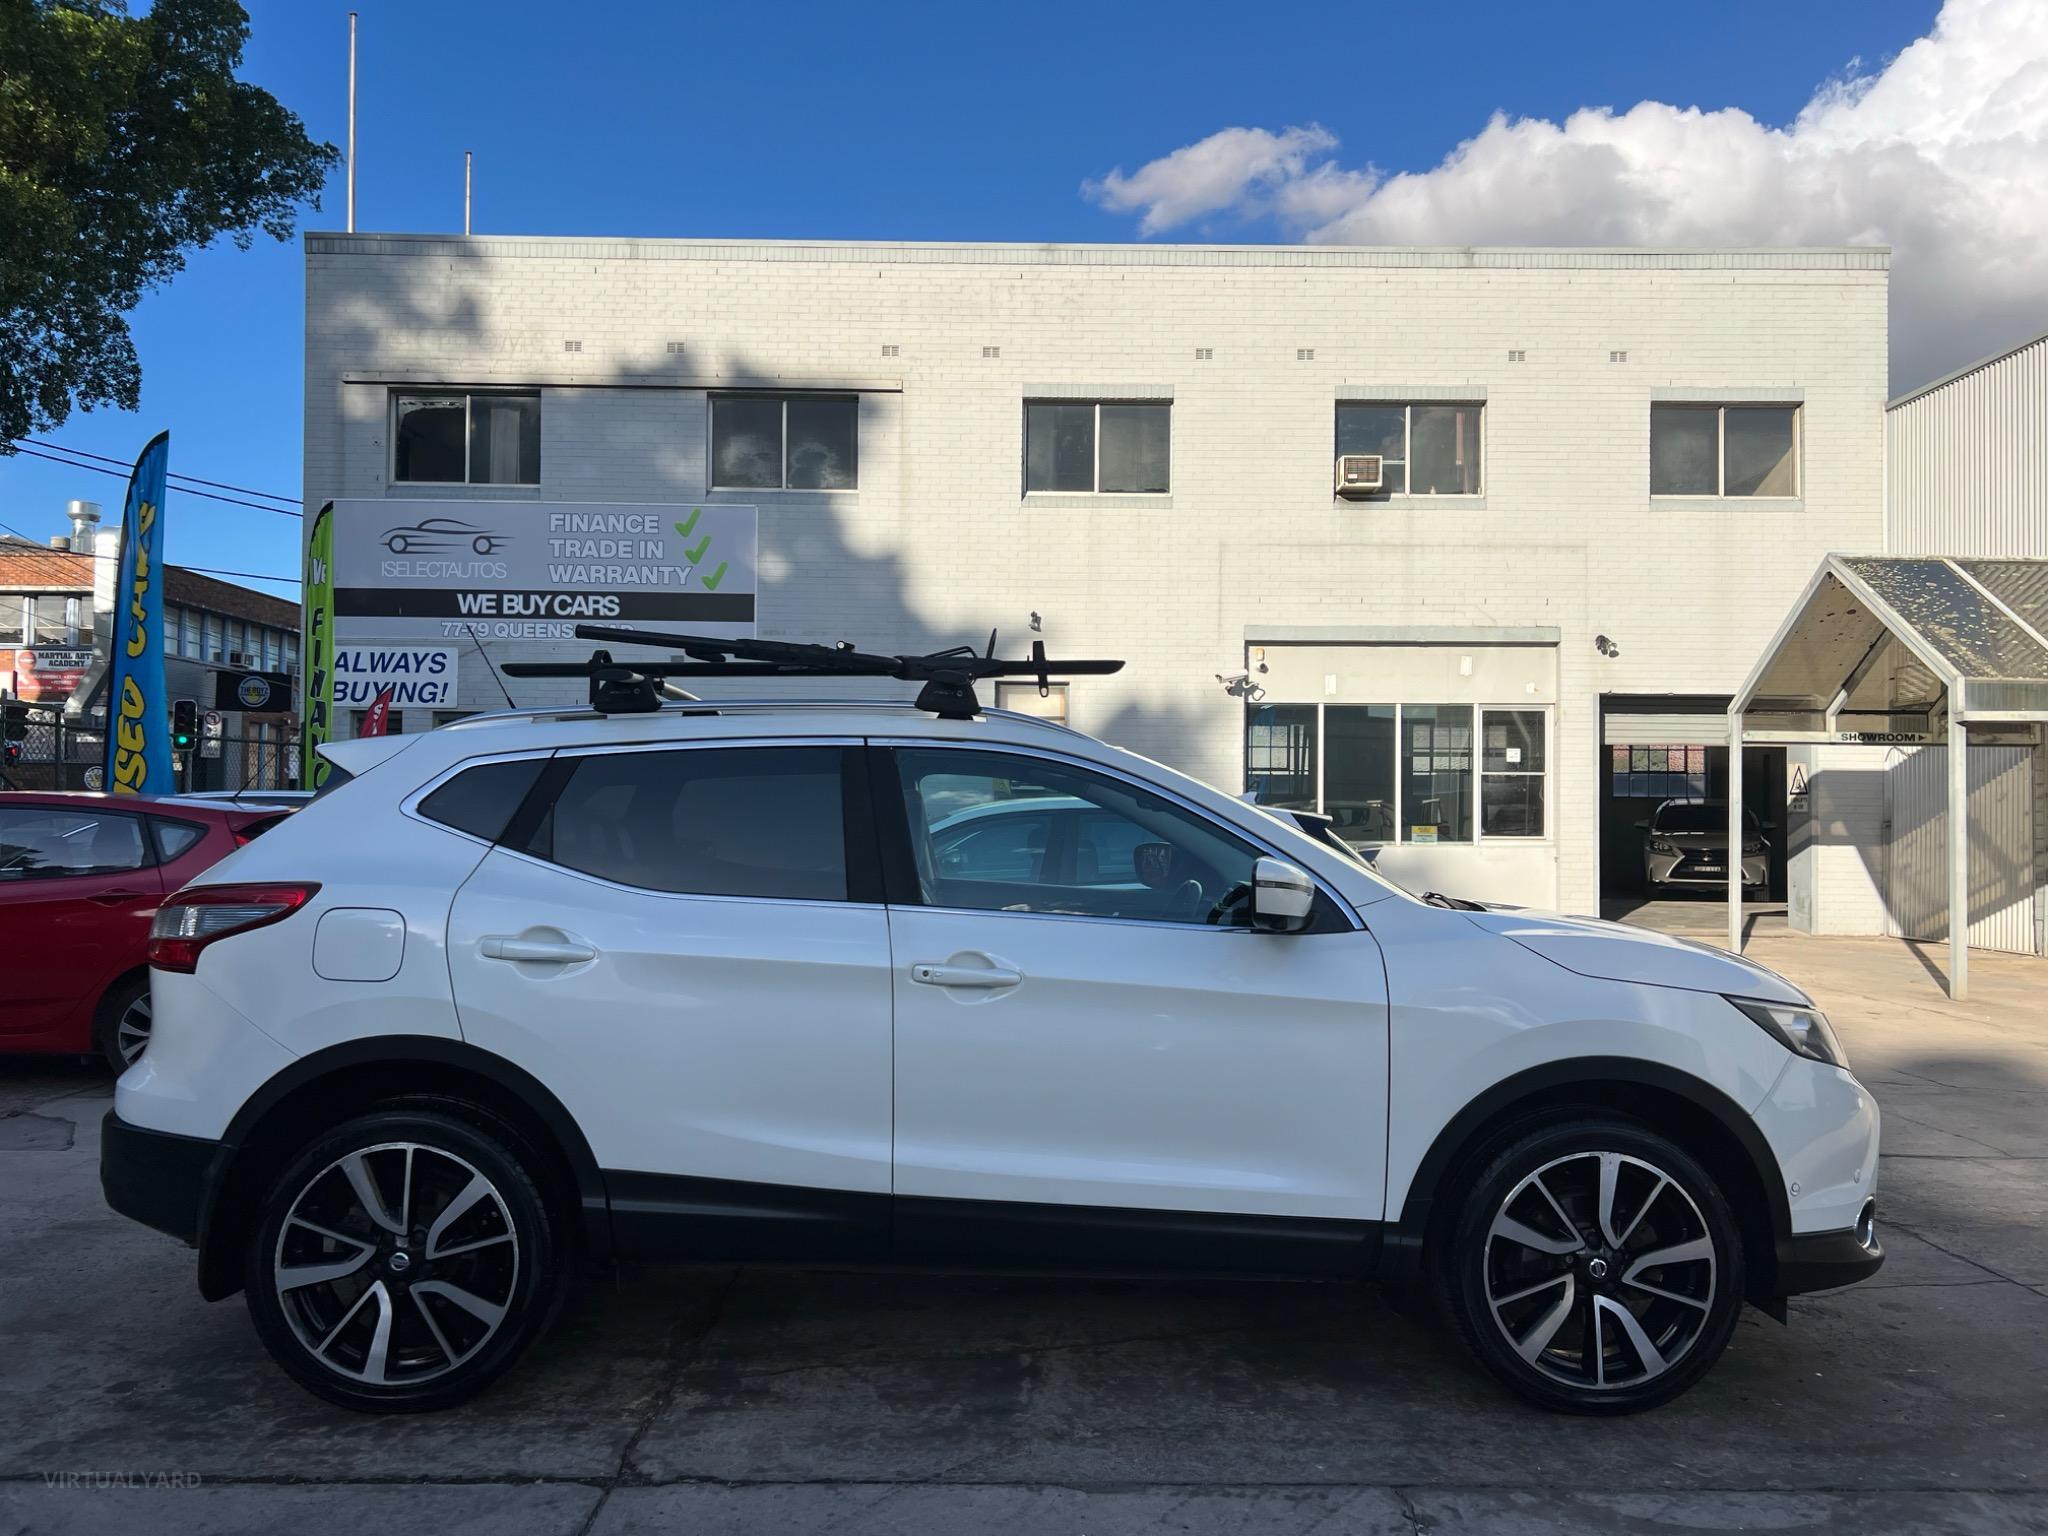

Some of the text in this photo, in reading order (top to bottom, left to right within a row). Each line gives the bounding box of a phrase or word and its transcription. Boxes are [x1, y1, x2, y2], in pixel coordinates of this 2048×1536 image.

[549, 512, 660, 534] FINANCE
[548, 538, 664, 559] TRADE IN
[381, 560, 508, 579] ISELECTAUTOS
[548, 563, 693, 585] WARRANTY
[457, 593, 621, 617] WE BUY CARS
[441, 621, 490, 638] 77-79
[493, 622, 576, 639] QUEENS
[38, 652, 73, 660] MARTIAL
[334, 651, 447, 674] ALWAYS
[333, 681, 449, 703] BUYING!
[1841, 732, 1916, 743] SHOWROOM
